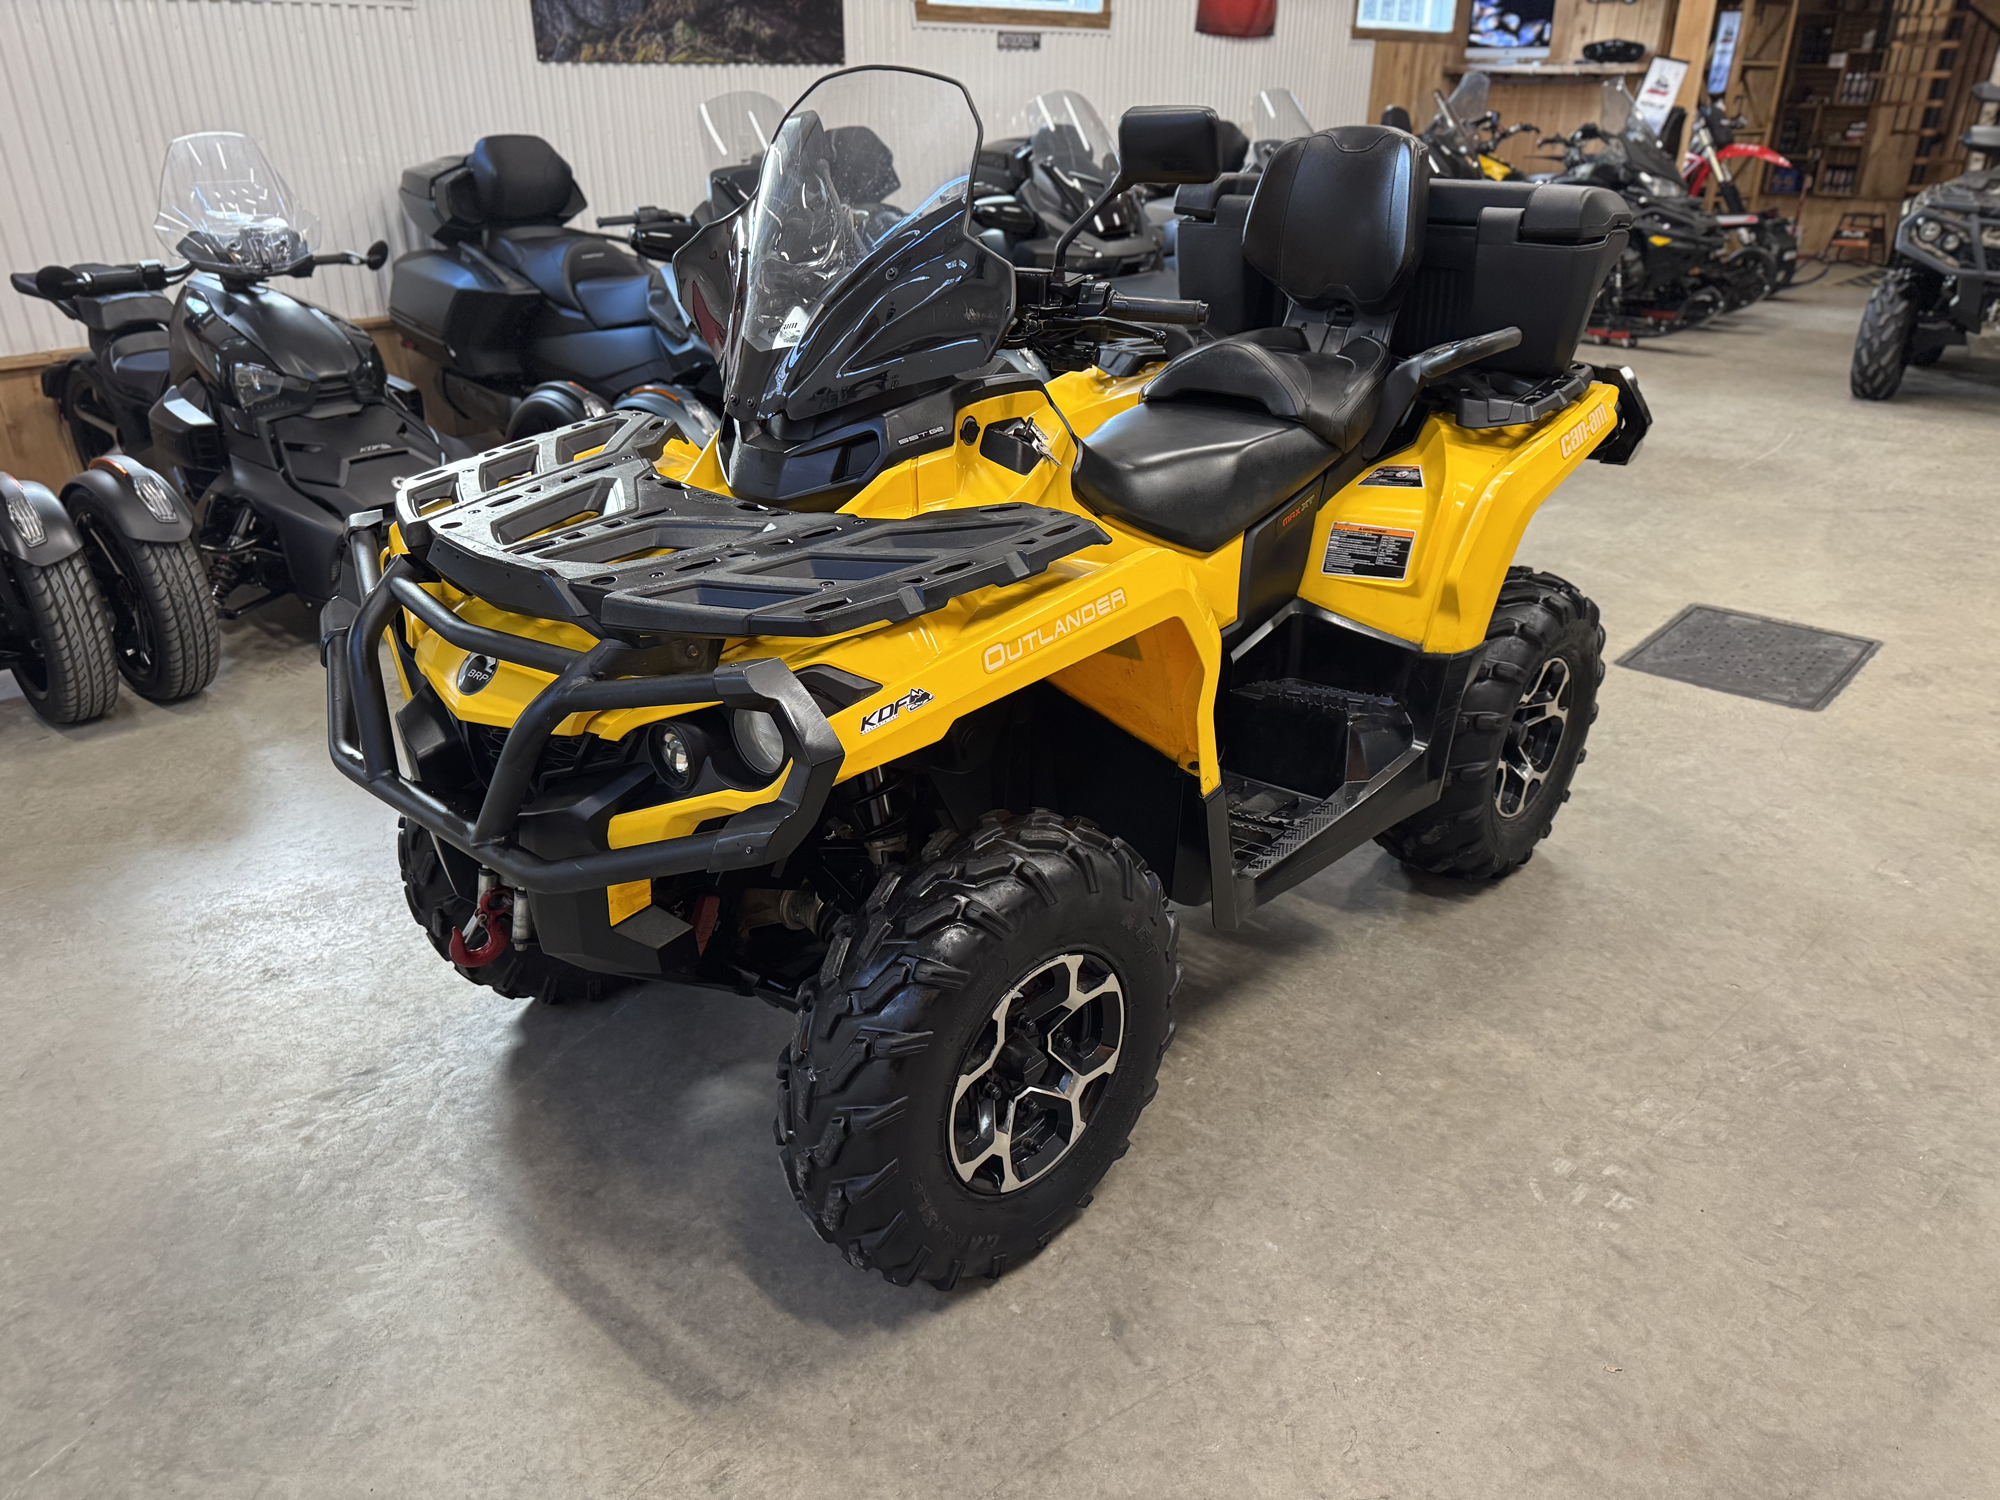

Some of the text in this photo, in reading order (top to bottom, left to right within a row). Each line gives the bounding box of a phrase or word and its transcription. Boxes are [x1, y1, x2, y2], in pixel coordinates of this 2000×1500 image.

[898, 426, 944, 445] SST G2
[1560, 403, 1608, 458] can-am
[1282, 495, 1315, 527] MAX XT
[984, 588, 1126, 672] OUTLANDER
[468, 669, 489, 681] BRP
[860, 694, 911, 732] KDF
